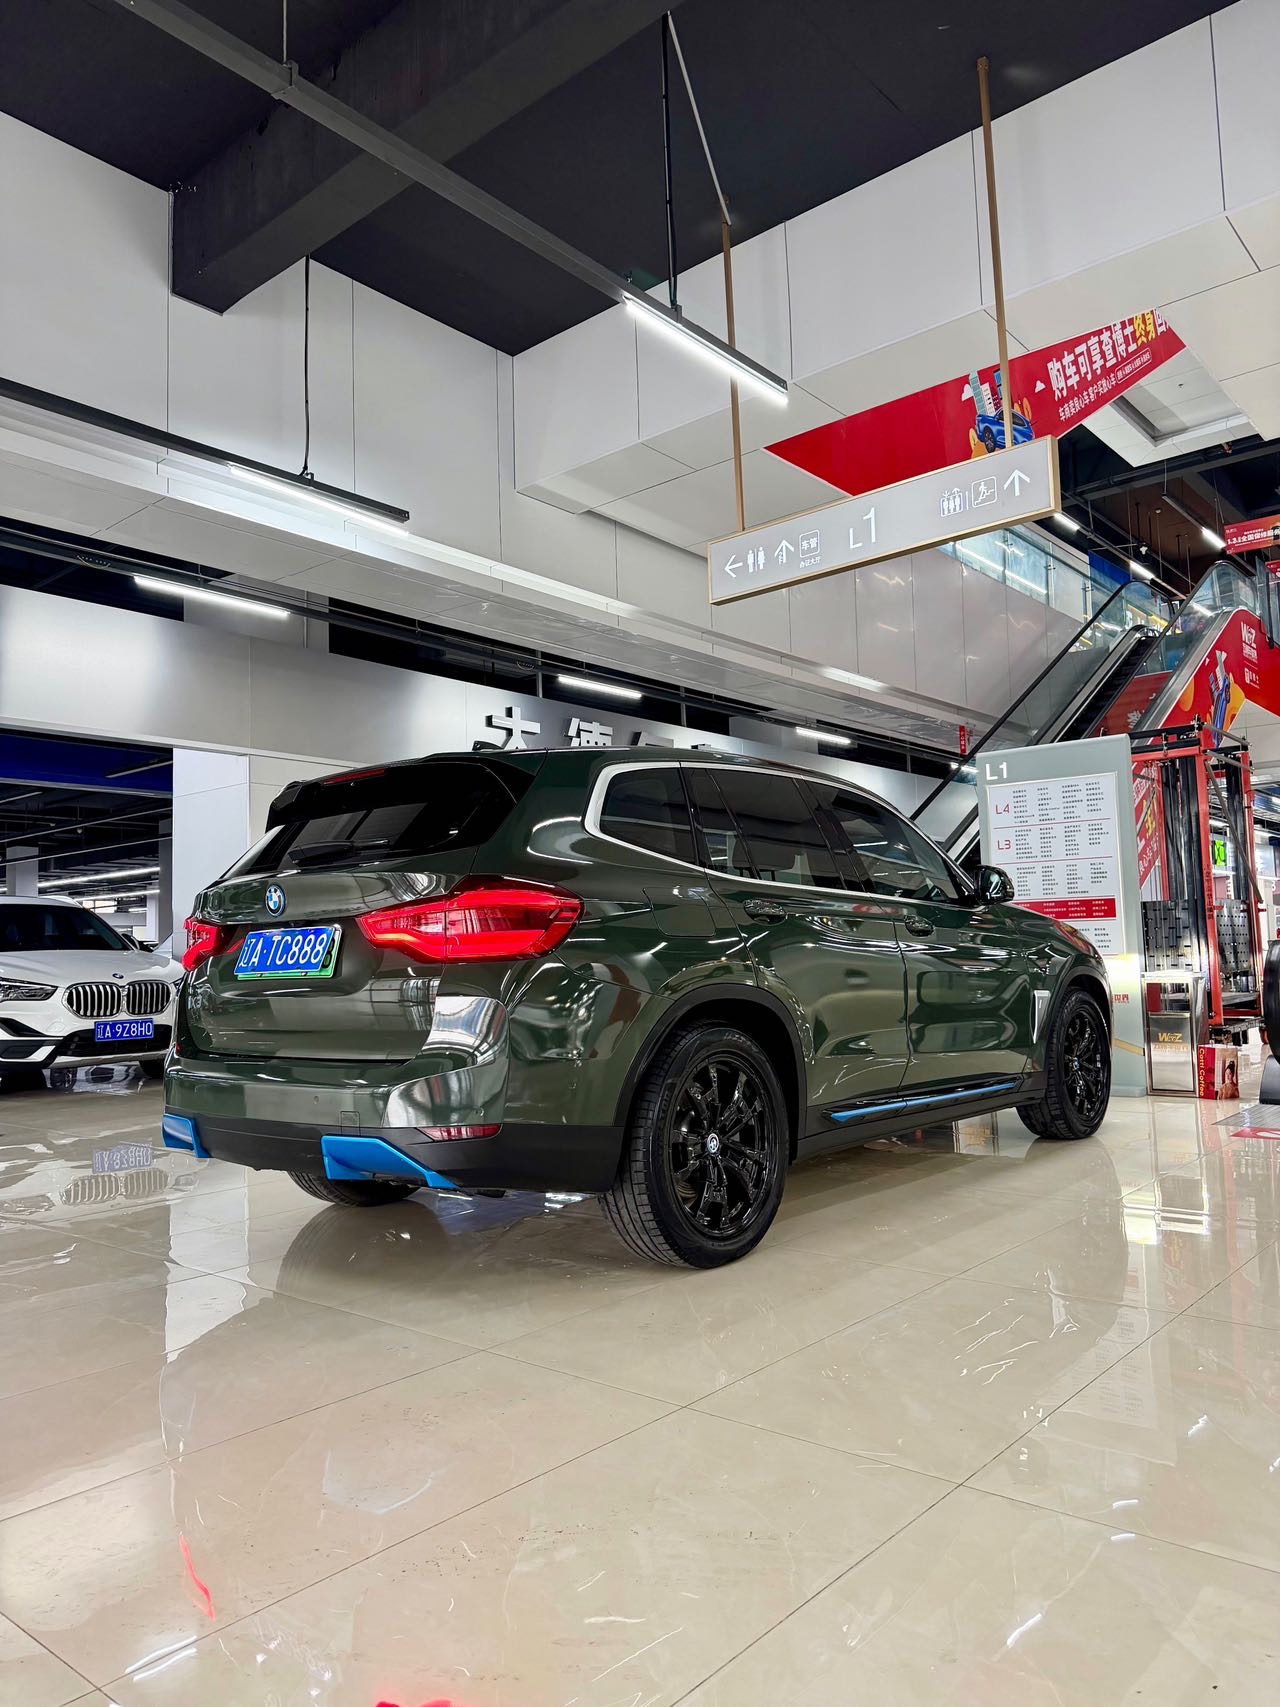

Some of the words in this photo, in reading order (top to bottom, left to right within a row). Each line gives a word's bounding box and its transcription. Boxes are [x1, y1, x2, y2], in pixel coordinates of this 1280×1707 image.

[849, 507, 876, 550] L1
[801, 537, 818, 551] 车管
[985, 761, 1007, 780] L1
[995, 803, 1010, 815] L4
[997, 839, 1012, 850] L3
